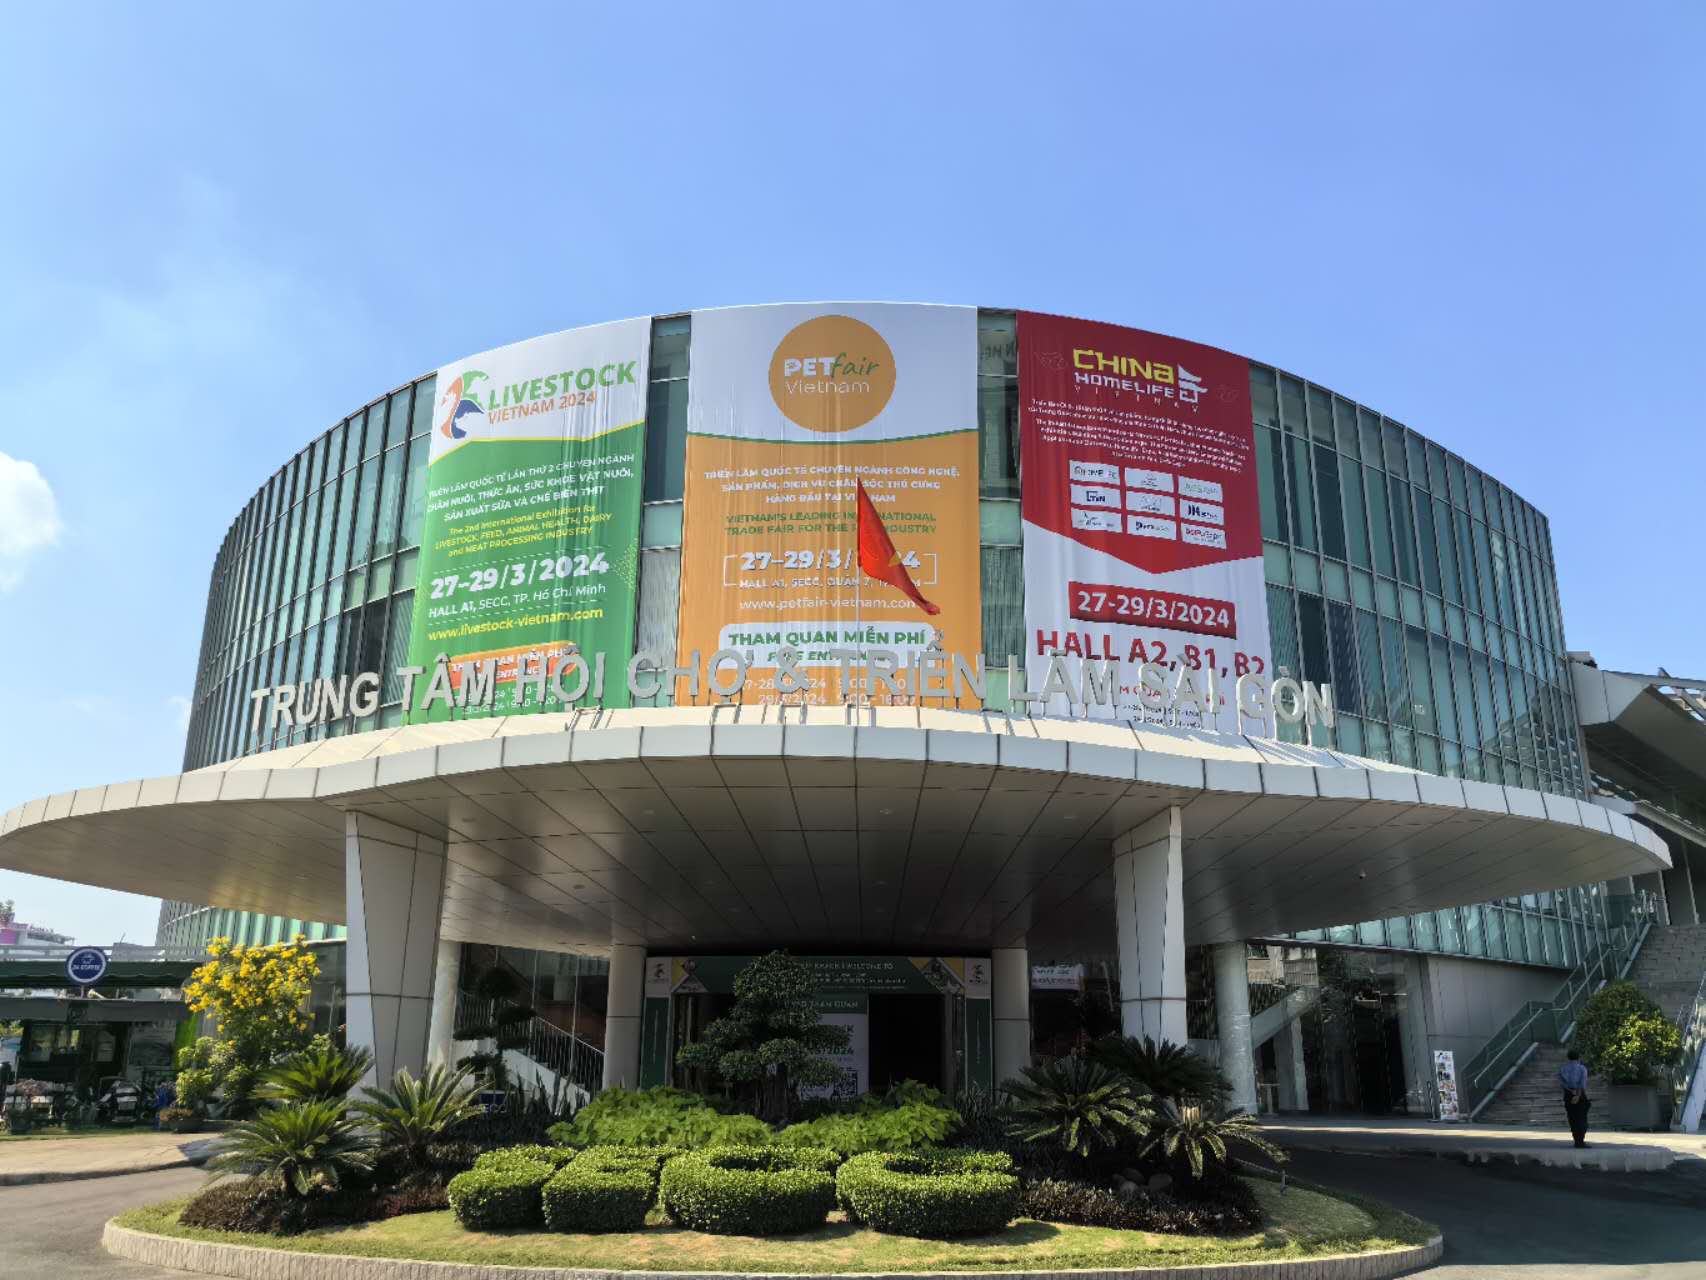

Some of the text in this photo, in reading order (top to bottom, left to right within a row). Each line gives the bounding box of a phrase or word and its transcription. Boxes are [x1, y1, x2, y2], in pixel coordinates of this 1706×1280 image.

[488, 361, 637, 410] LIVESTOCK
[487, 390, 597, 425] VIETNAM 2024
[725, 526, 763, 536] TRADE
[767, 525, 794, 534] FAIR
[799, 524, 821, 533] FOR
[826, 523, 848, 532] THE
[430, 552, 609, 599] 27-29/3/2024
[428, 605, 458, 618] HALL
[479, 596, 511, 609] SECC,
[575, 584, 606, 596] Minh
[1077, 591, 1230, 628] 27-29/3/2024
[428, 608, 603, 641] www.livestock-vietnam.com
[728, 626, 926, 646] THAM QUAN MIỄN PHÍ
[1037, 629, 1264, 678] HALL A2, B1, B2
[251, 672, 380, 731] TRUNG
[397, 652, 497, 711] TÂM
[628, 648, 754, 704] CHỢ
[775, 646, 809, 694] &
[831, 629, 985, 699] TRIỂN
[1139, 654, 1220, 713] SÀI
[1236, 665, 1335, 728] GÒN
